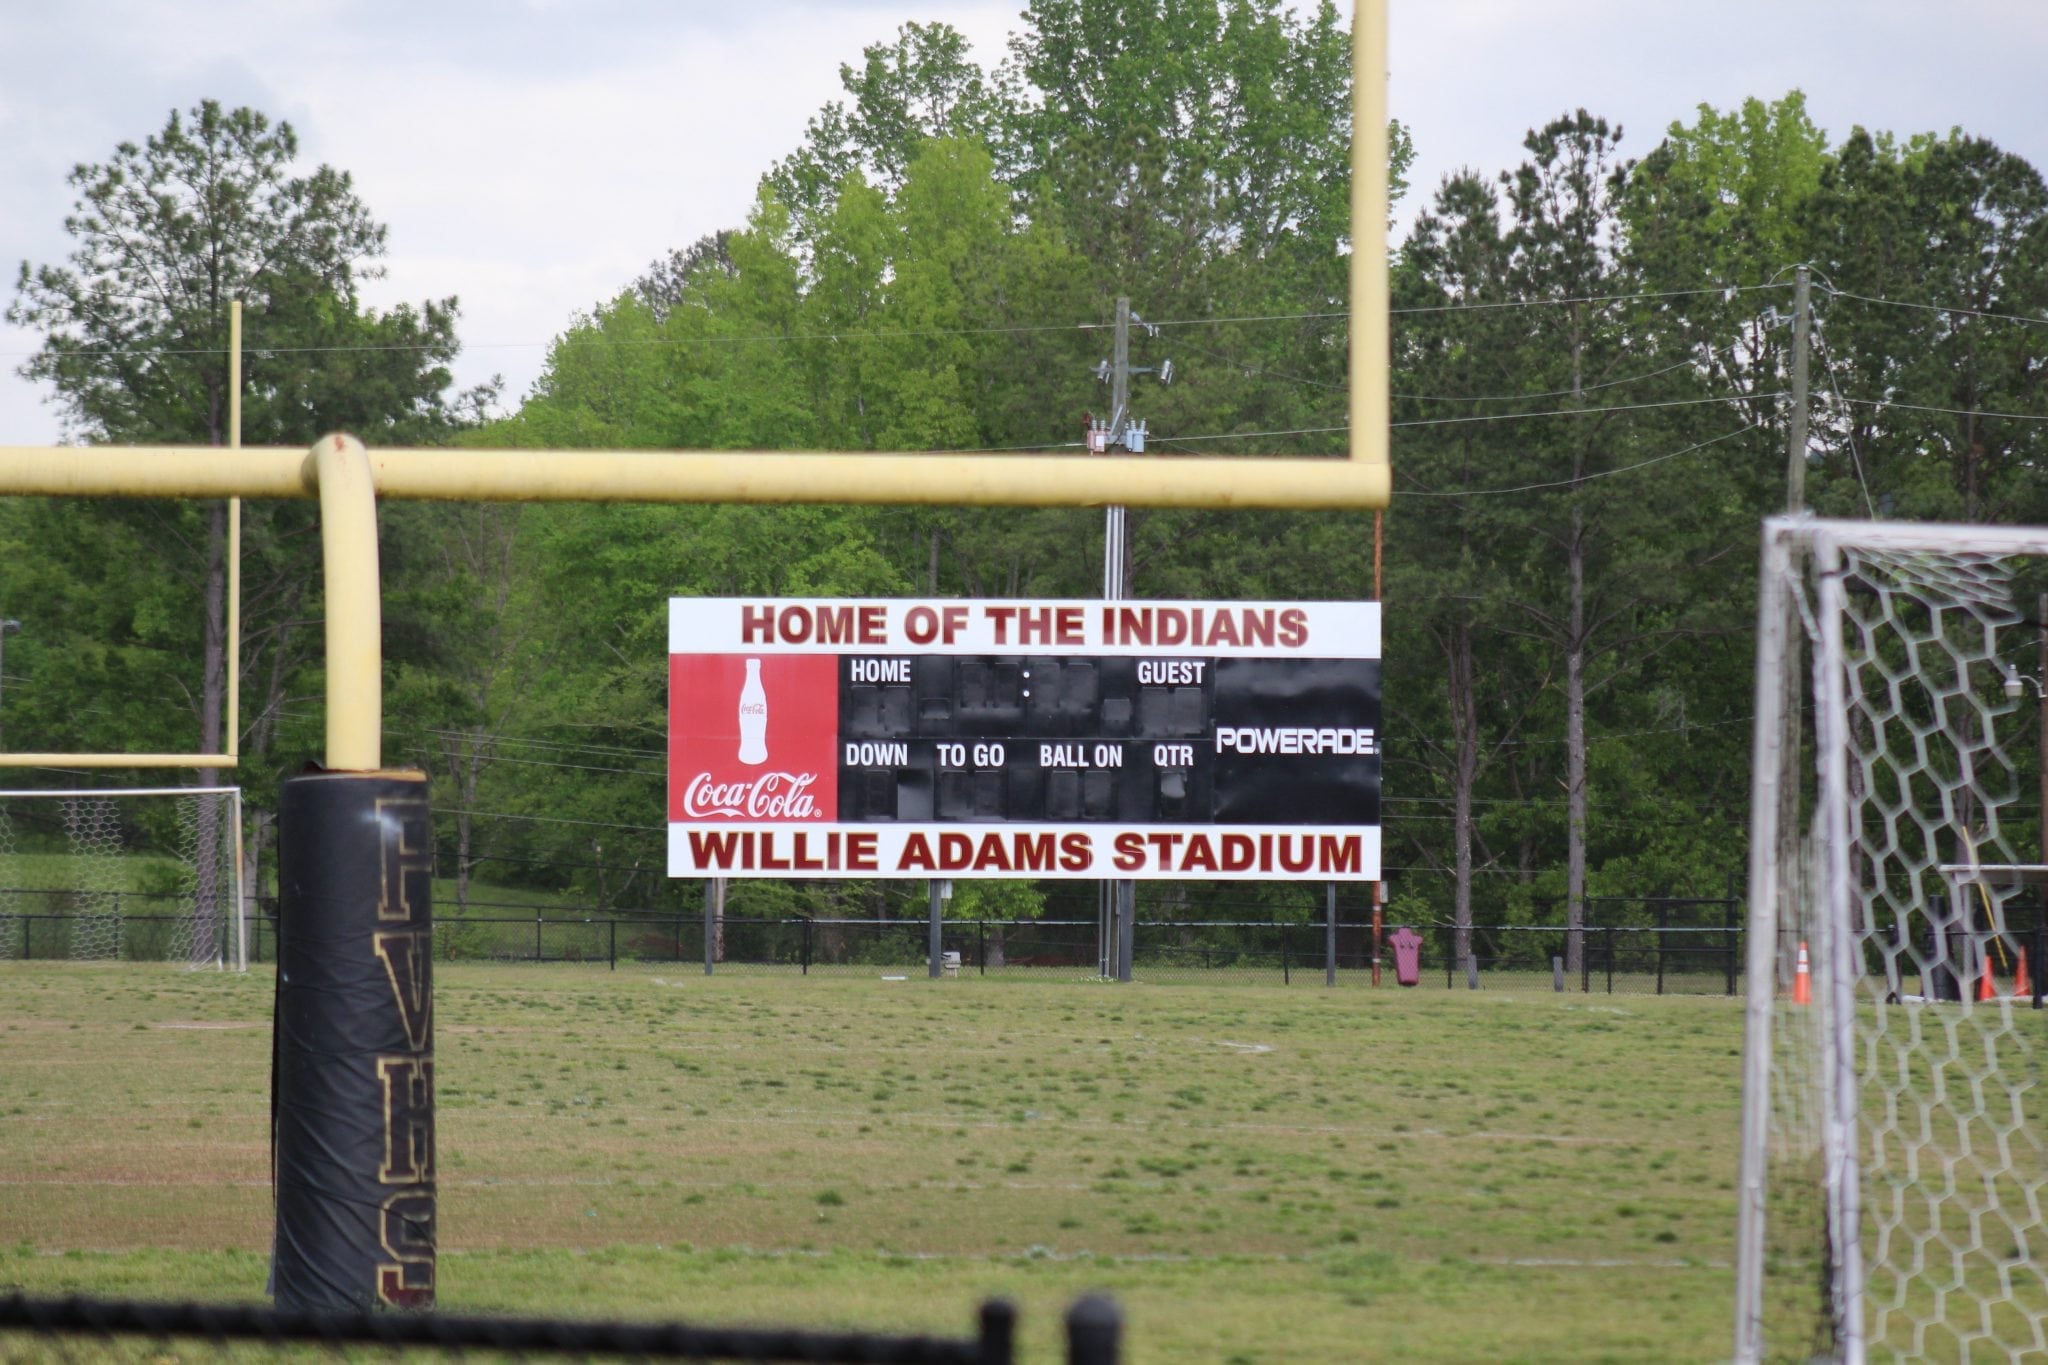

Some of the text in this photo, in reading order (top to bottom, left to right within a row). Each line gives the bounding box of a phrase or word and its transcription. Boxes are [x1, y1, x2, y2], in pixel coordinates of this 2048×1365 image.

[741, 605, 1309, 648] HOME OF THE INDIANS
[851, 659, 911, 683] HOME
[1137, 661, 1205, 684] GUEST
[1216, 727, 1374, 754] POWERADE
[846, 743, 908, 767] DOWN
[937, 743, 1005, 767] TO GO
[1040, 744, 1123, 767] BALL ON
[1154, 745, 1194, 767] QTR
[687, 831, 1363, 874] WILLIE ADAMS STADIUM
